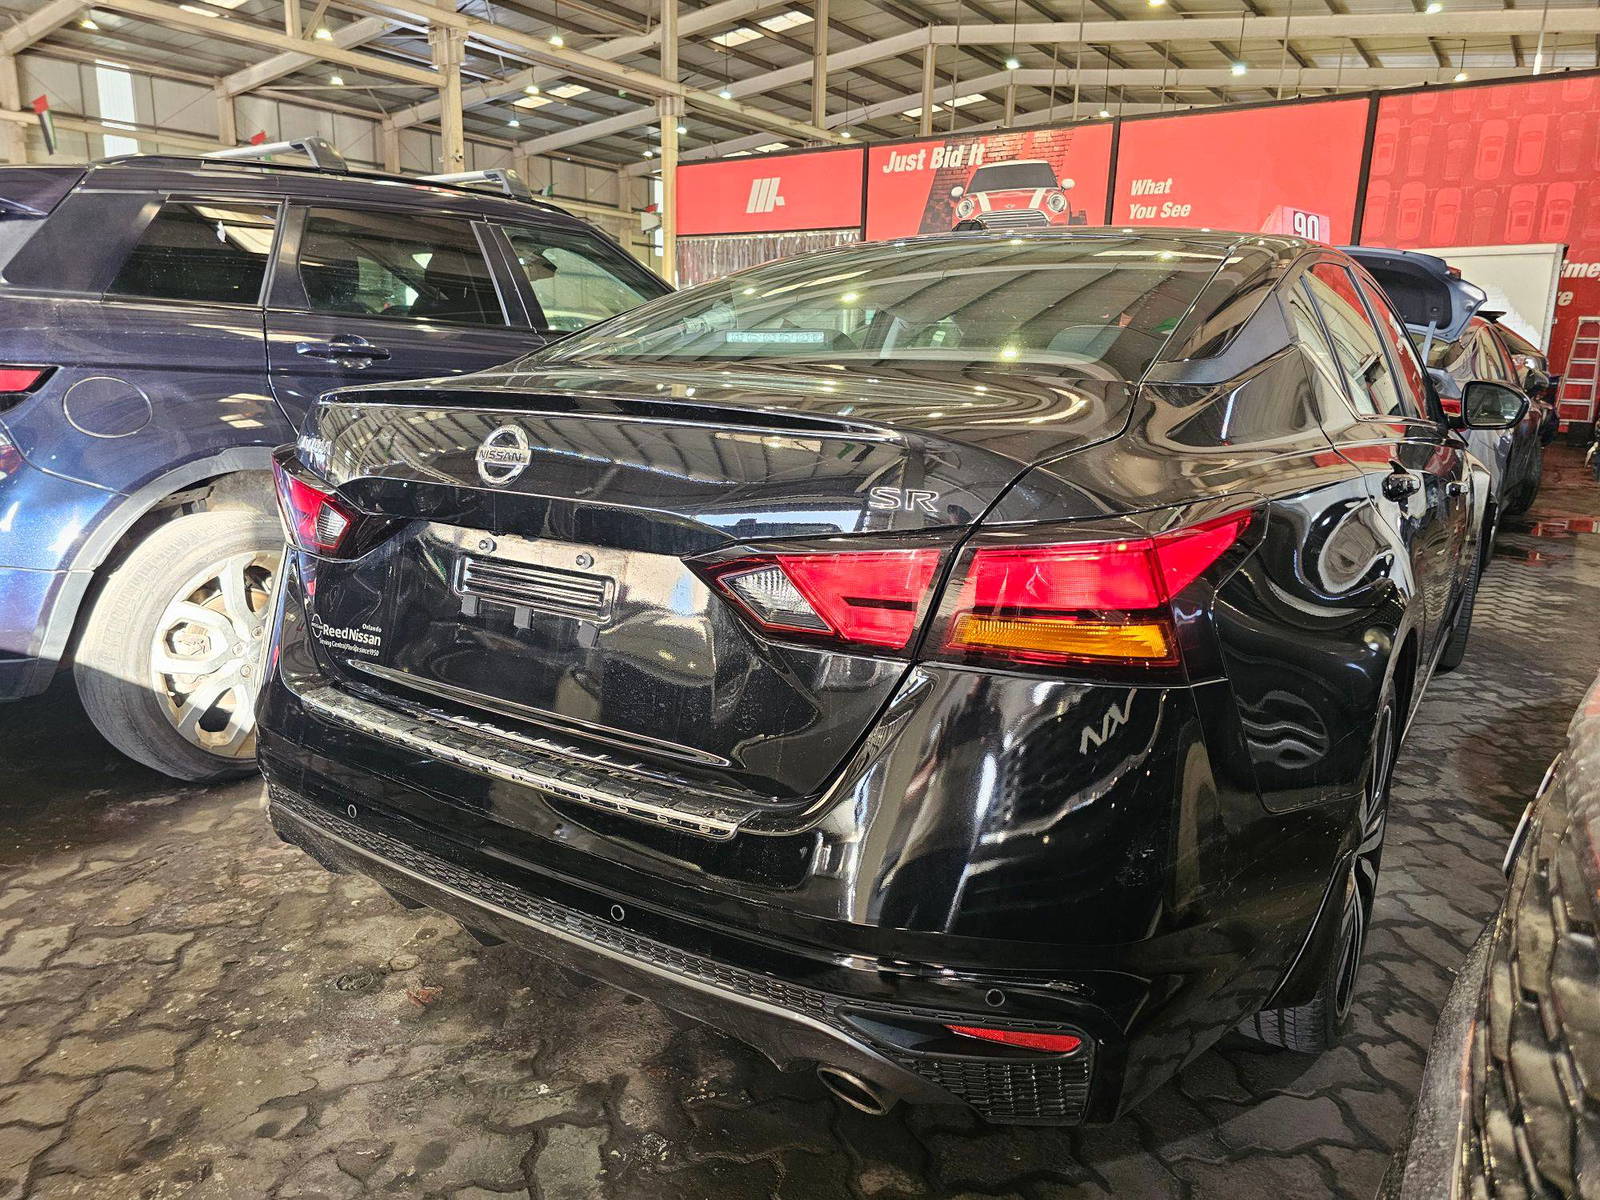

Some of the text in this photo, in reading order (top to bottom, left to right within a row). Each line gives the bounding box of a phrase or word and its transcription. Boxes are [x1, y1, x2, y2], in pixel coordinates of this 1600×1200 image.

[882, 143, 986, 173] Just Bid It
[1130, 178, 1173, 196] What
[1129, 201, 1192, 220] You See
[478, 449, 523, 462] NISSAN
[868, 486, 940, 513] SR
